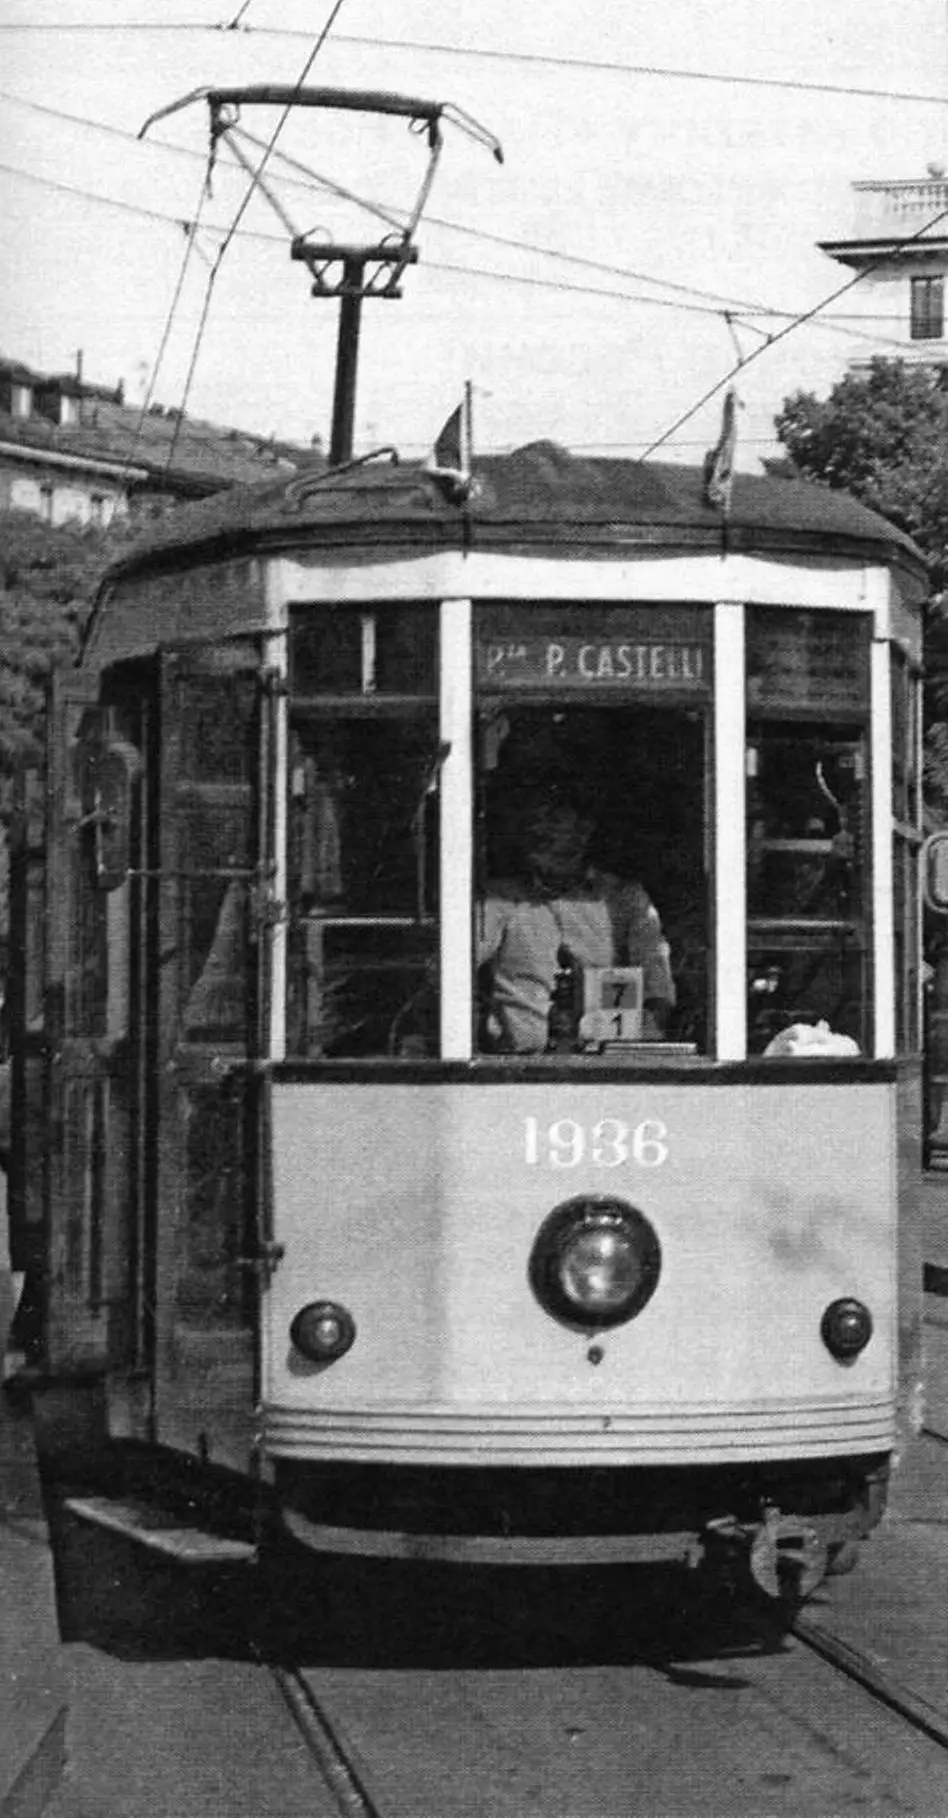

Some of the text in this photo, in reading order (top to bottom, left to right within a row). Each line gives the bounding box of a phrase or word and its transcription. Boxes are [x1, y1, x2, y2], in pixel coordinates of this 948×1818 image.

[545, 643, 566, 678] P.
[577, 645, 703, 680] CASTELLI
[611, 982, 628, 1008] 7
[611, 1013, 623, 1037] 1
[522, 1115, 669, 1168] 1936
